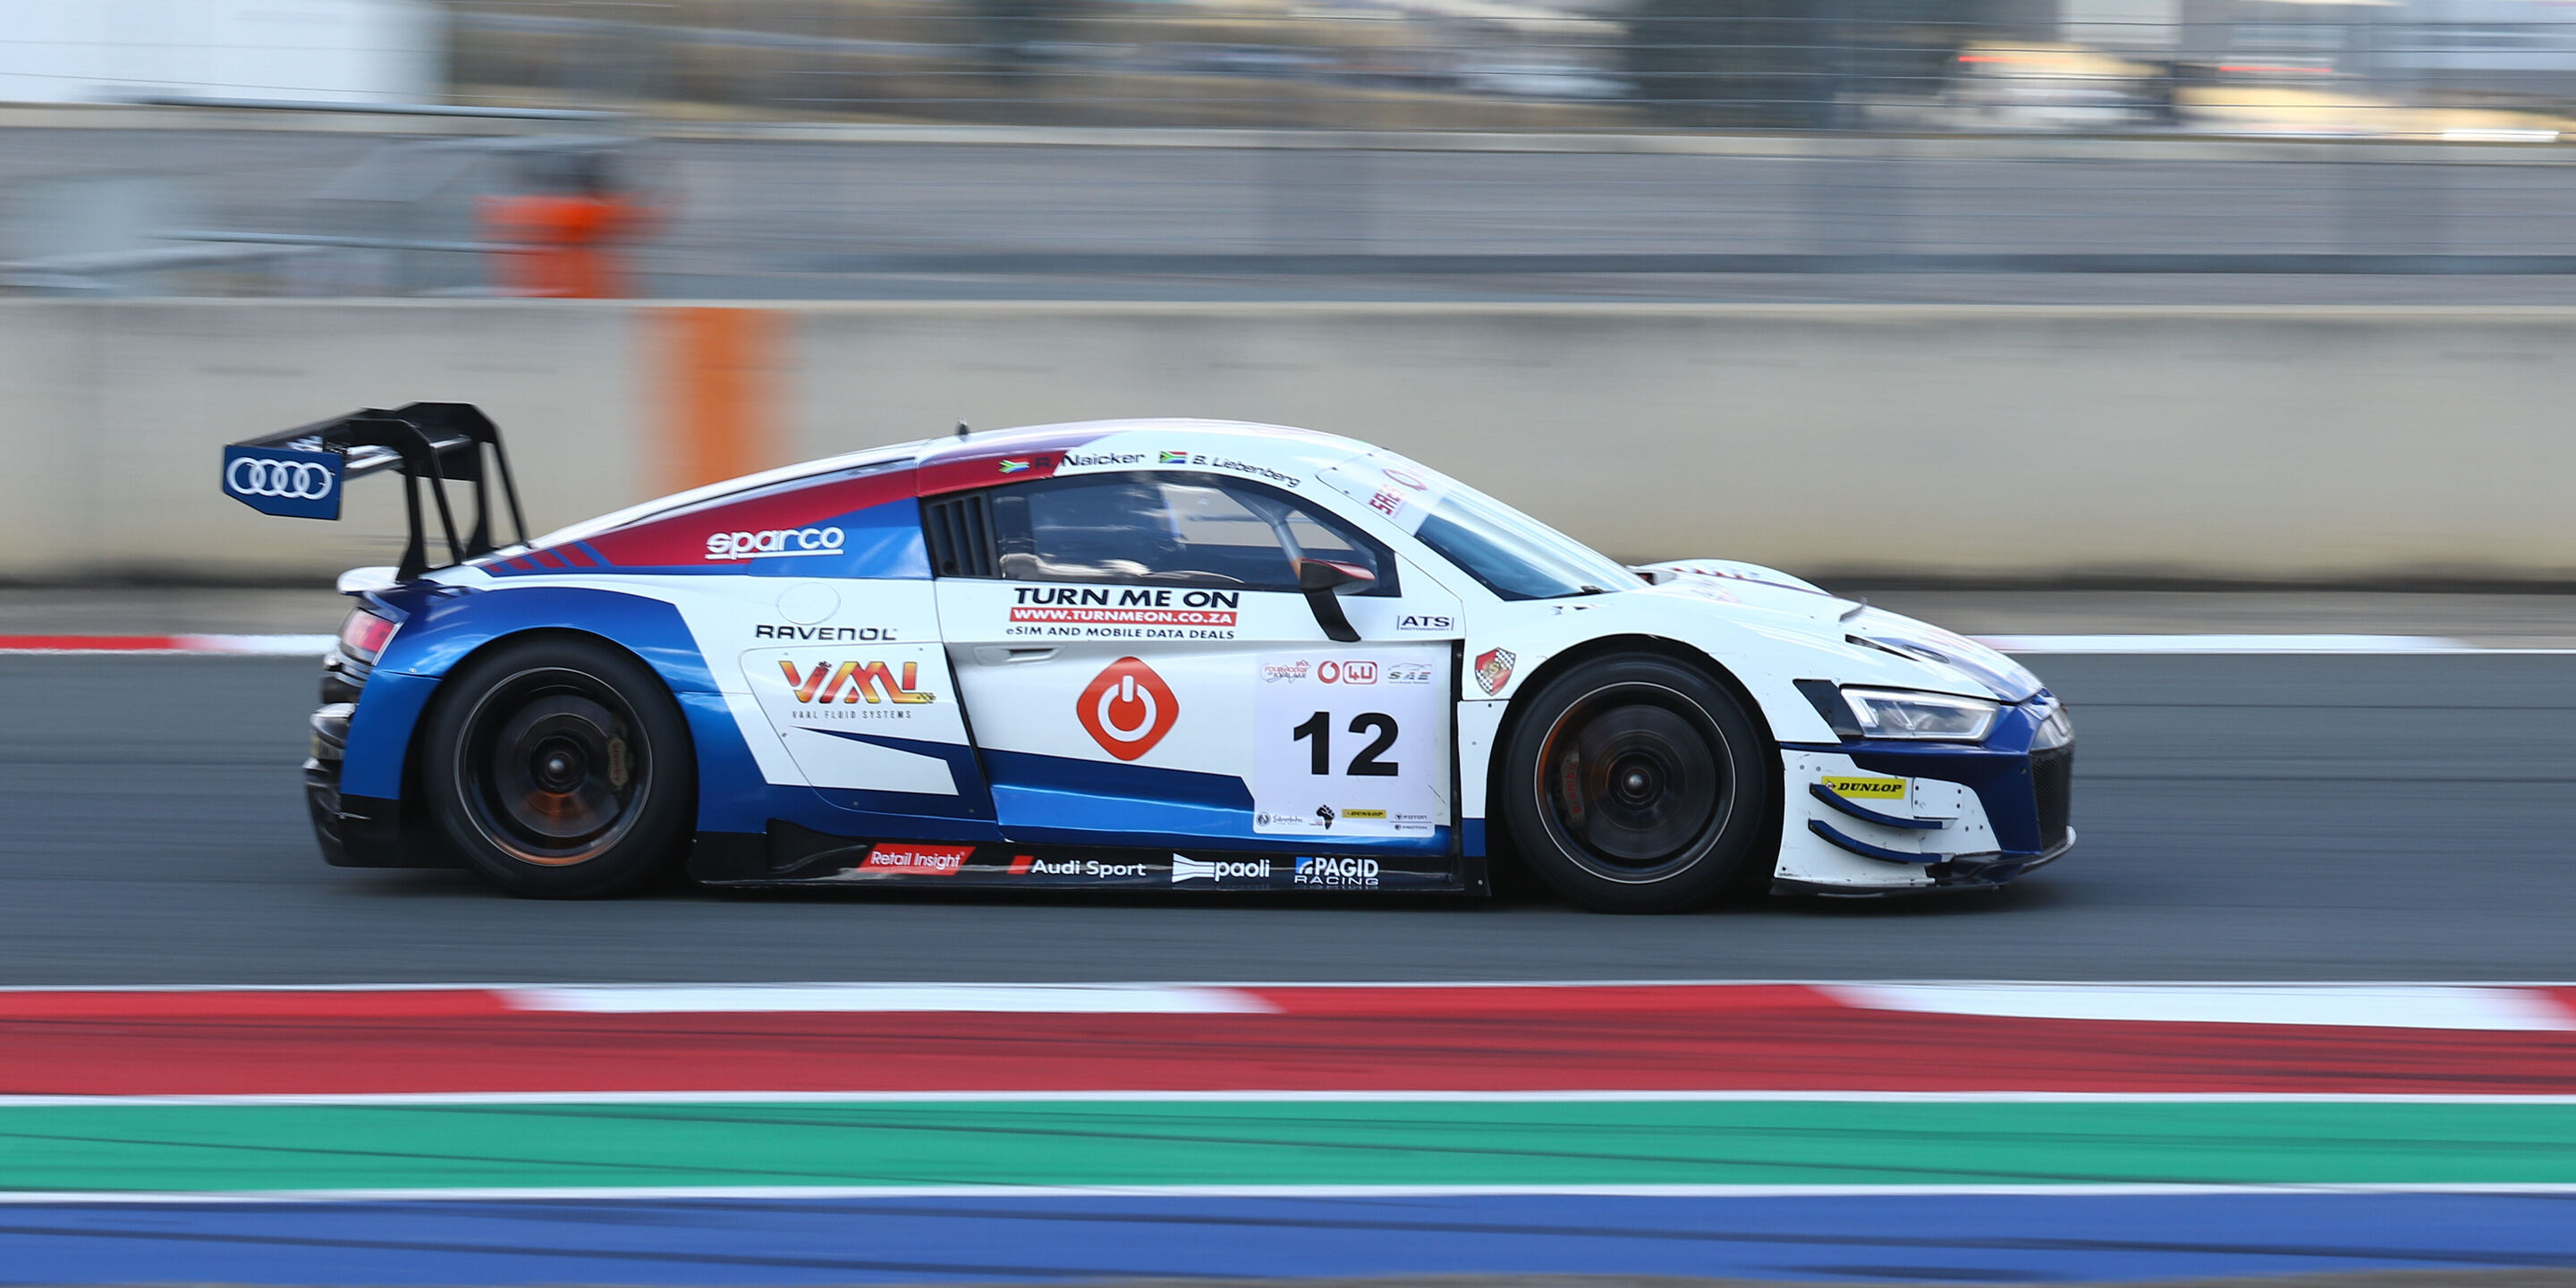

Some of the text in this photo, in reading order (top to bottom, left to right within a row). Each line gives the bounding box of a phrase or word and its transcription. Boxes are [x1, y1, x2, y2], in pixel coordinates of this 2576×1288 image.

[1062, 452, 1146, 467] Naicker
[1192, 454, 1301, 488] B. Liebenberg
[706, 526, 845, 561] sparco
[1014, 588, 1240, 609] TURN ME ON
[1013, 608, 1233, 624] WWW.TURNMEON.CO.ZA
[1402, 615, 1451, 628] ATS
[756, 624, 897, 640] RAVENOL
[1005, 625, 1235, 640] eSIM AND MOBILE DATA DEALS
[862, 710, 911, 719] SYSTEMS
[1293, 711, 1399, 776] 12
[1837, 782, 1902, 792] DUNLOP
[870, 851, 962, 870] Retail Insight
[1031, 859, 1147, 878] Audi Sport
[1315, 856, 1379, 878] PAGID
[1215, 859, 1270, 883] paoli
[1294, 875, 1379, 886] RACING
